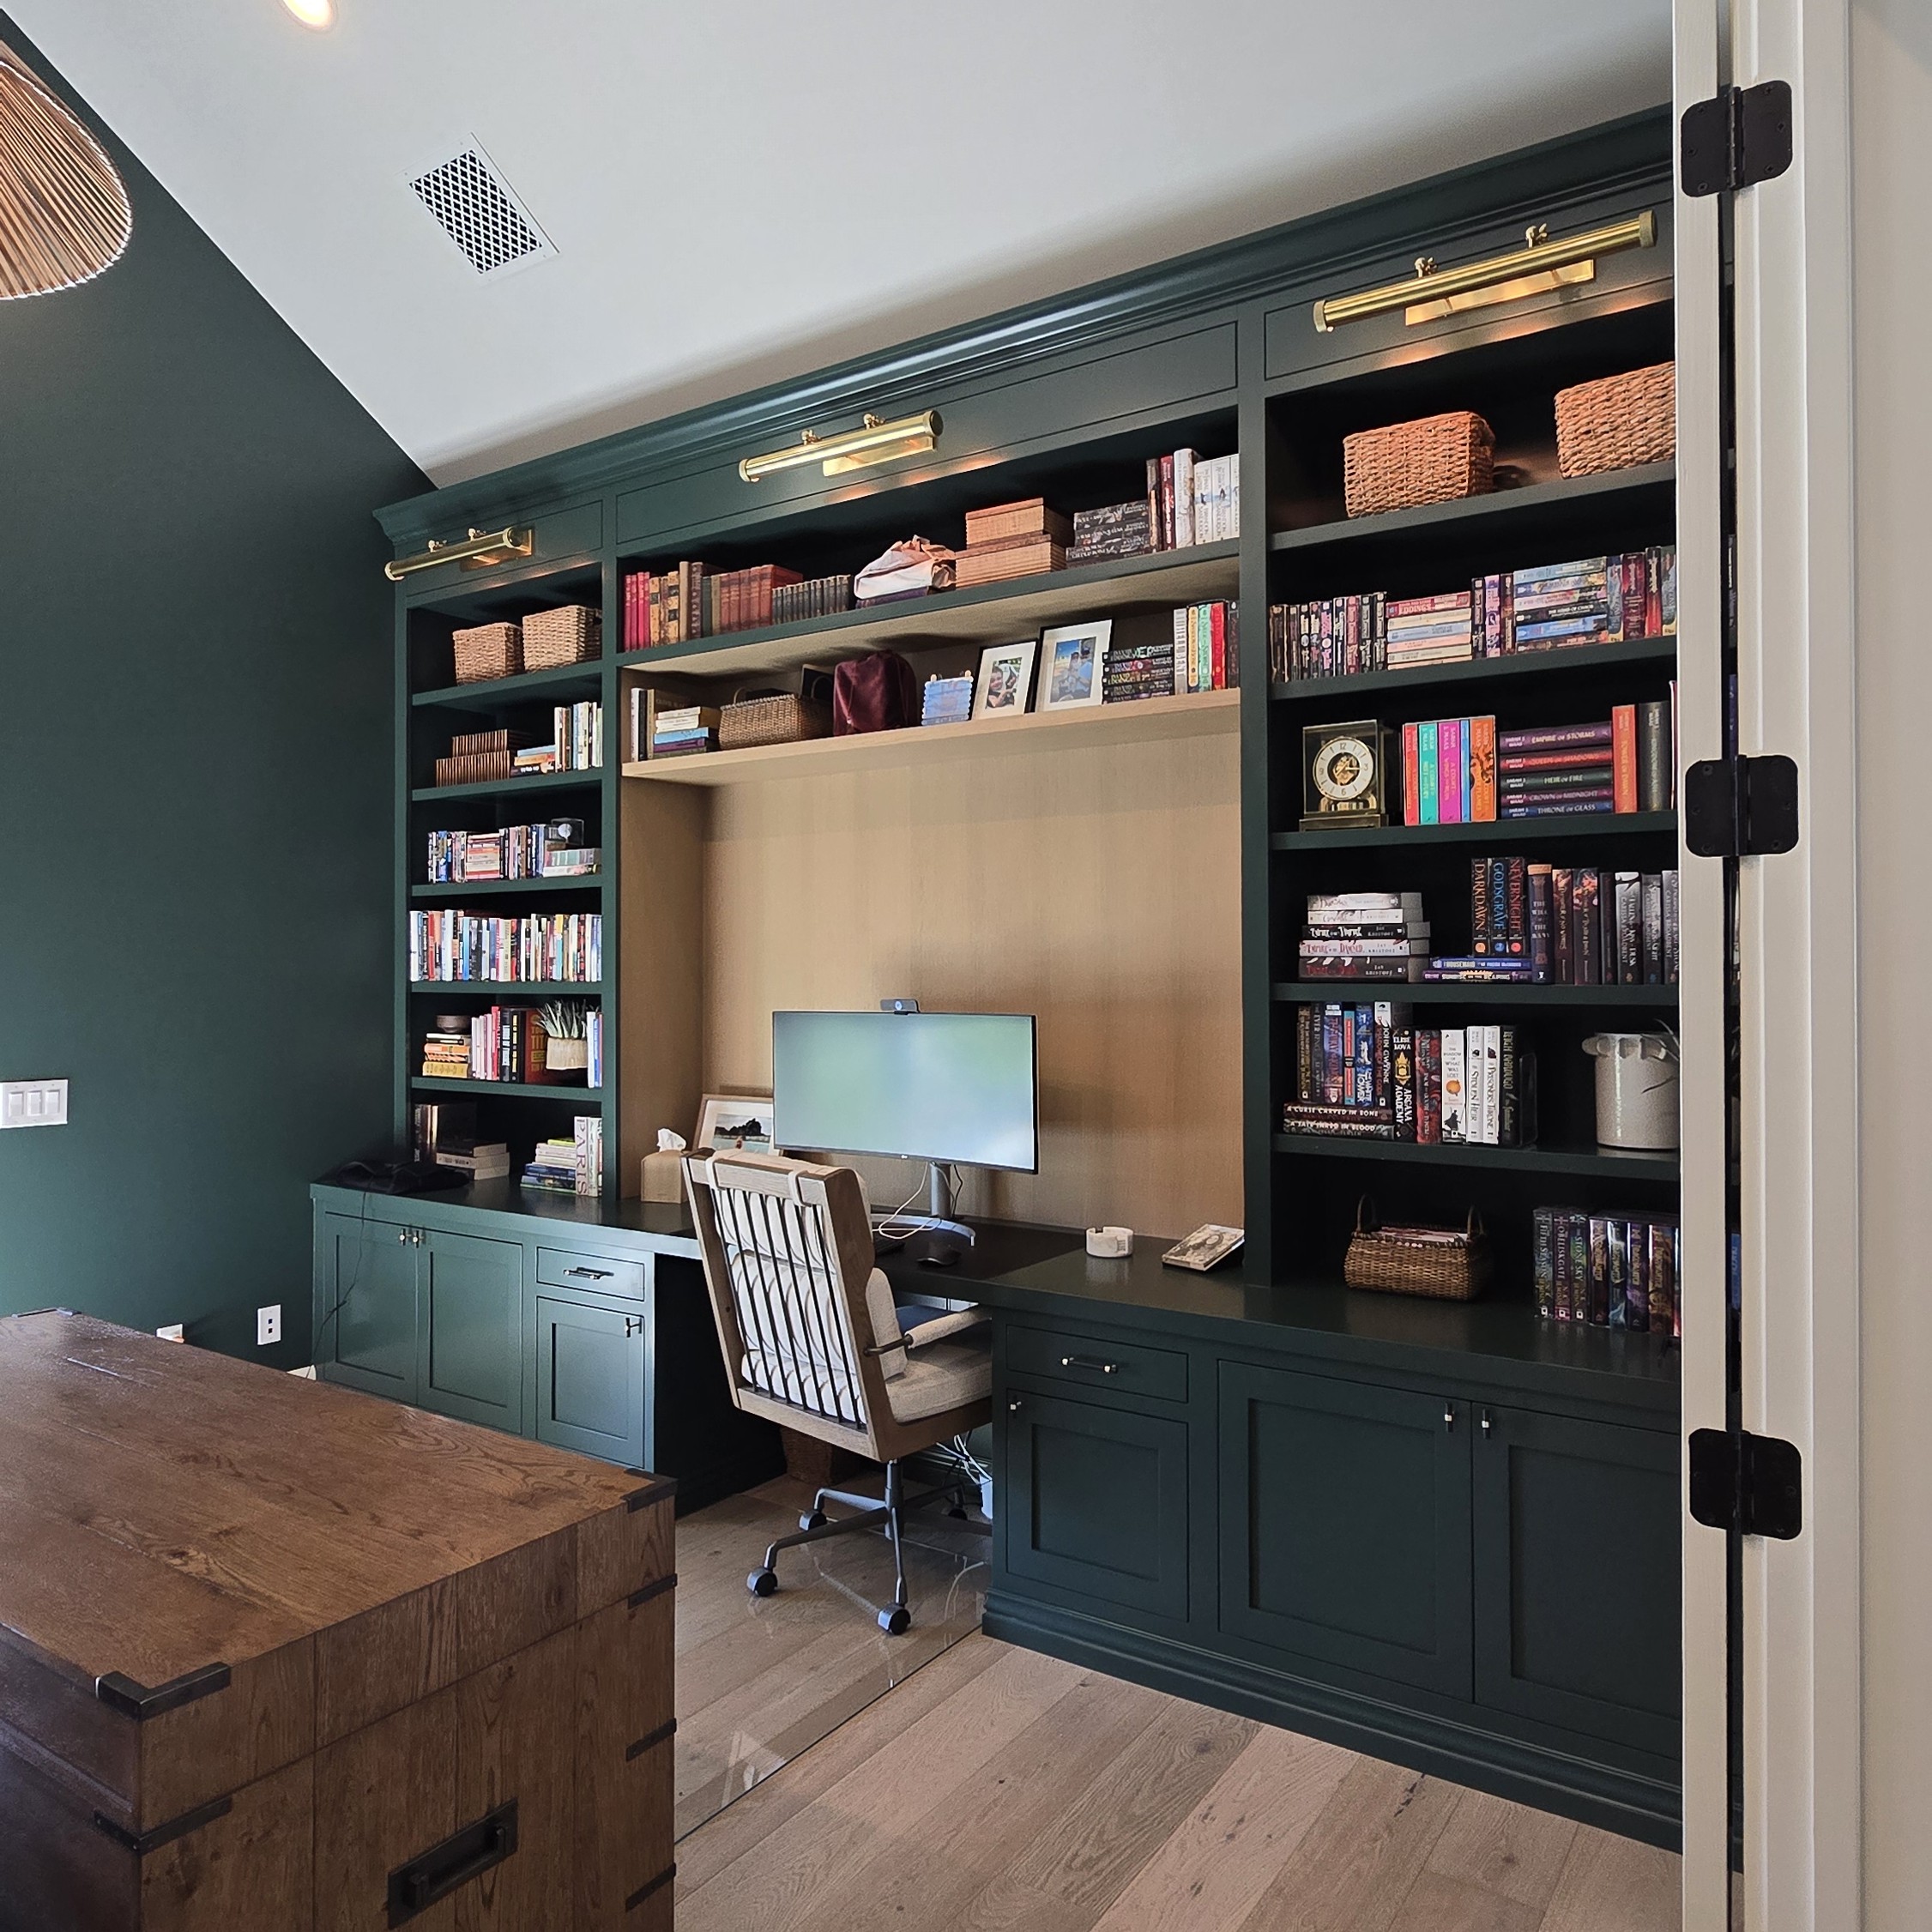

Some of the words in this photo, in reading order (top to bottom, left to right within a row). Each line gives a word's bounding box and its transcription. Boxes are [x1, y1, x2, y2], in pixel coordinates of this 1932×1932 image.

[1399, 604, 1431, 615] EDDINGS
[1339, 742, 1347, 751] 12
[1531, 734, 1556, 743] EMPIRE
[1567, 731, 1595, 740] STORMS
[1341, 788, 1346, 796] 6
[1543, 776, 1560, 784] HEIR
[1473, 863, 1488, 931] DARKDAWN
[1493, 862, 1508, 930] GODSGRAVE
[1509, 859, 1523, 931] NEVERNIGHT
[1503, 1031, 1513, 1052] LEIGH
[1382, 1049, 1391, 1084] GWYNNE
[1503, 1054, 1513, 1090] BARDUGO
[1357, 1072, 1367, 1102] TOWER
[1470, 1071, 1479, 1101] STOLEN
[1395, 1084, 1405, 1125] ACADEMY
[1404, 1088, 1413, 1122] ARCANA
[1470, 1102, 1480, 1121] HEIR
[1486, 1102, 1495, 1129] THRONE
[576, 1119, 588, 1194] PARIS
[1540, 1224, 1549, 1247] FIFTH
[1557, 1225, 1566, 1259] OBELISK
[1574, 1236, 1583, 1263] STONE
[1539, 1247, 1549, 1278] SEASON
[1557, 1259, 1566, 1279] GATE
